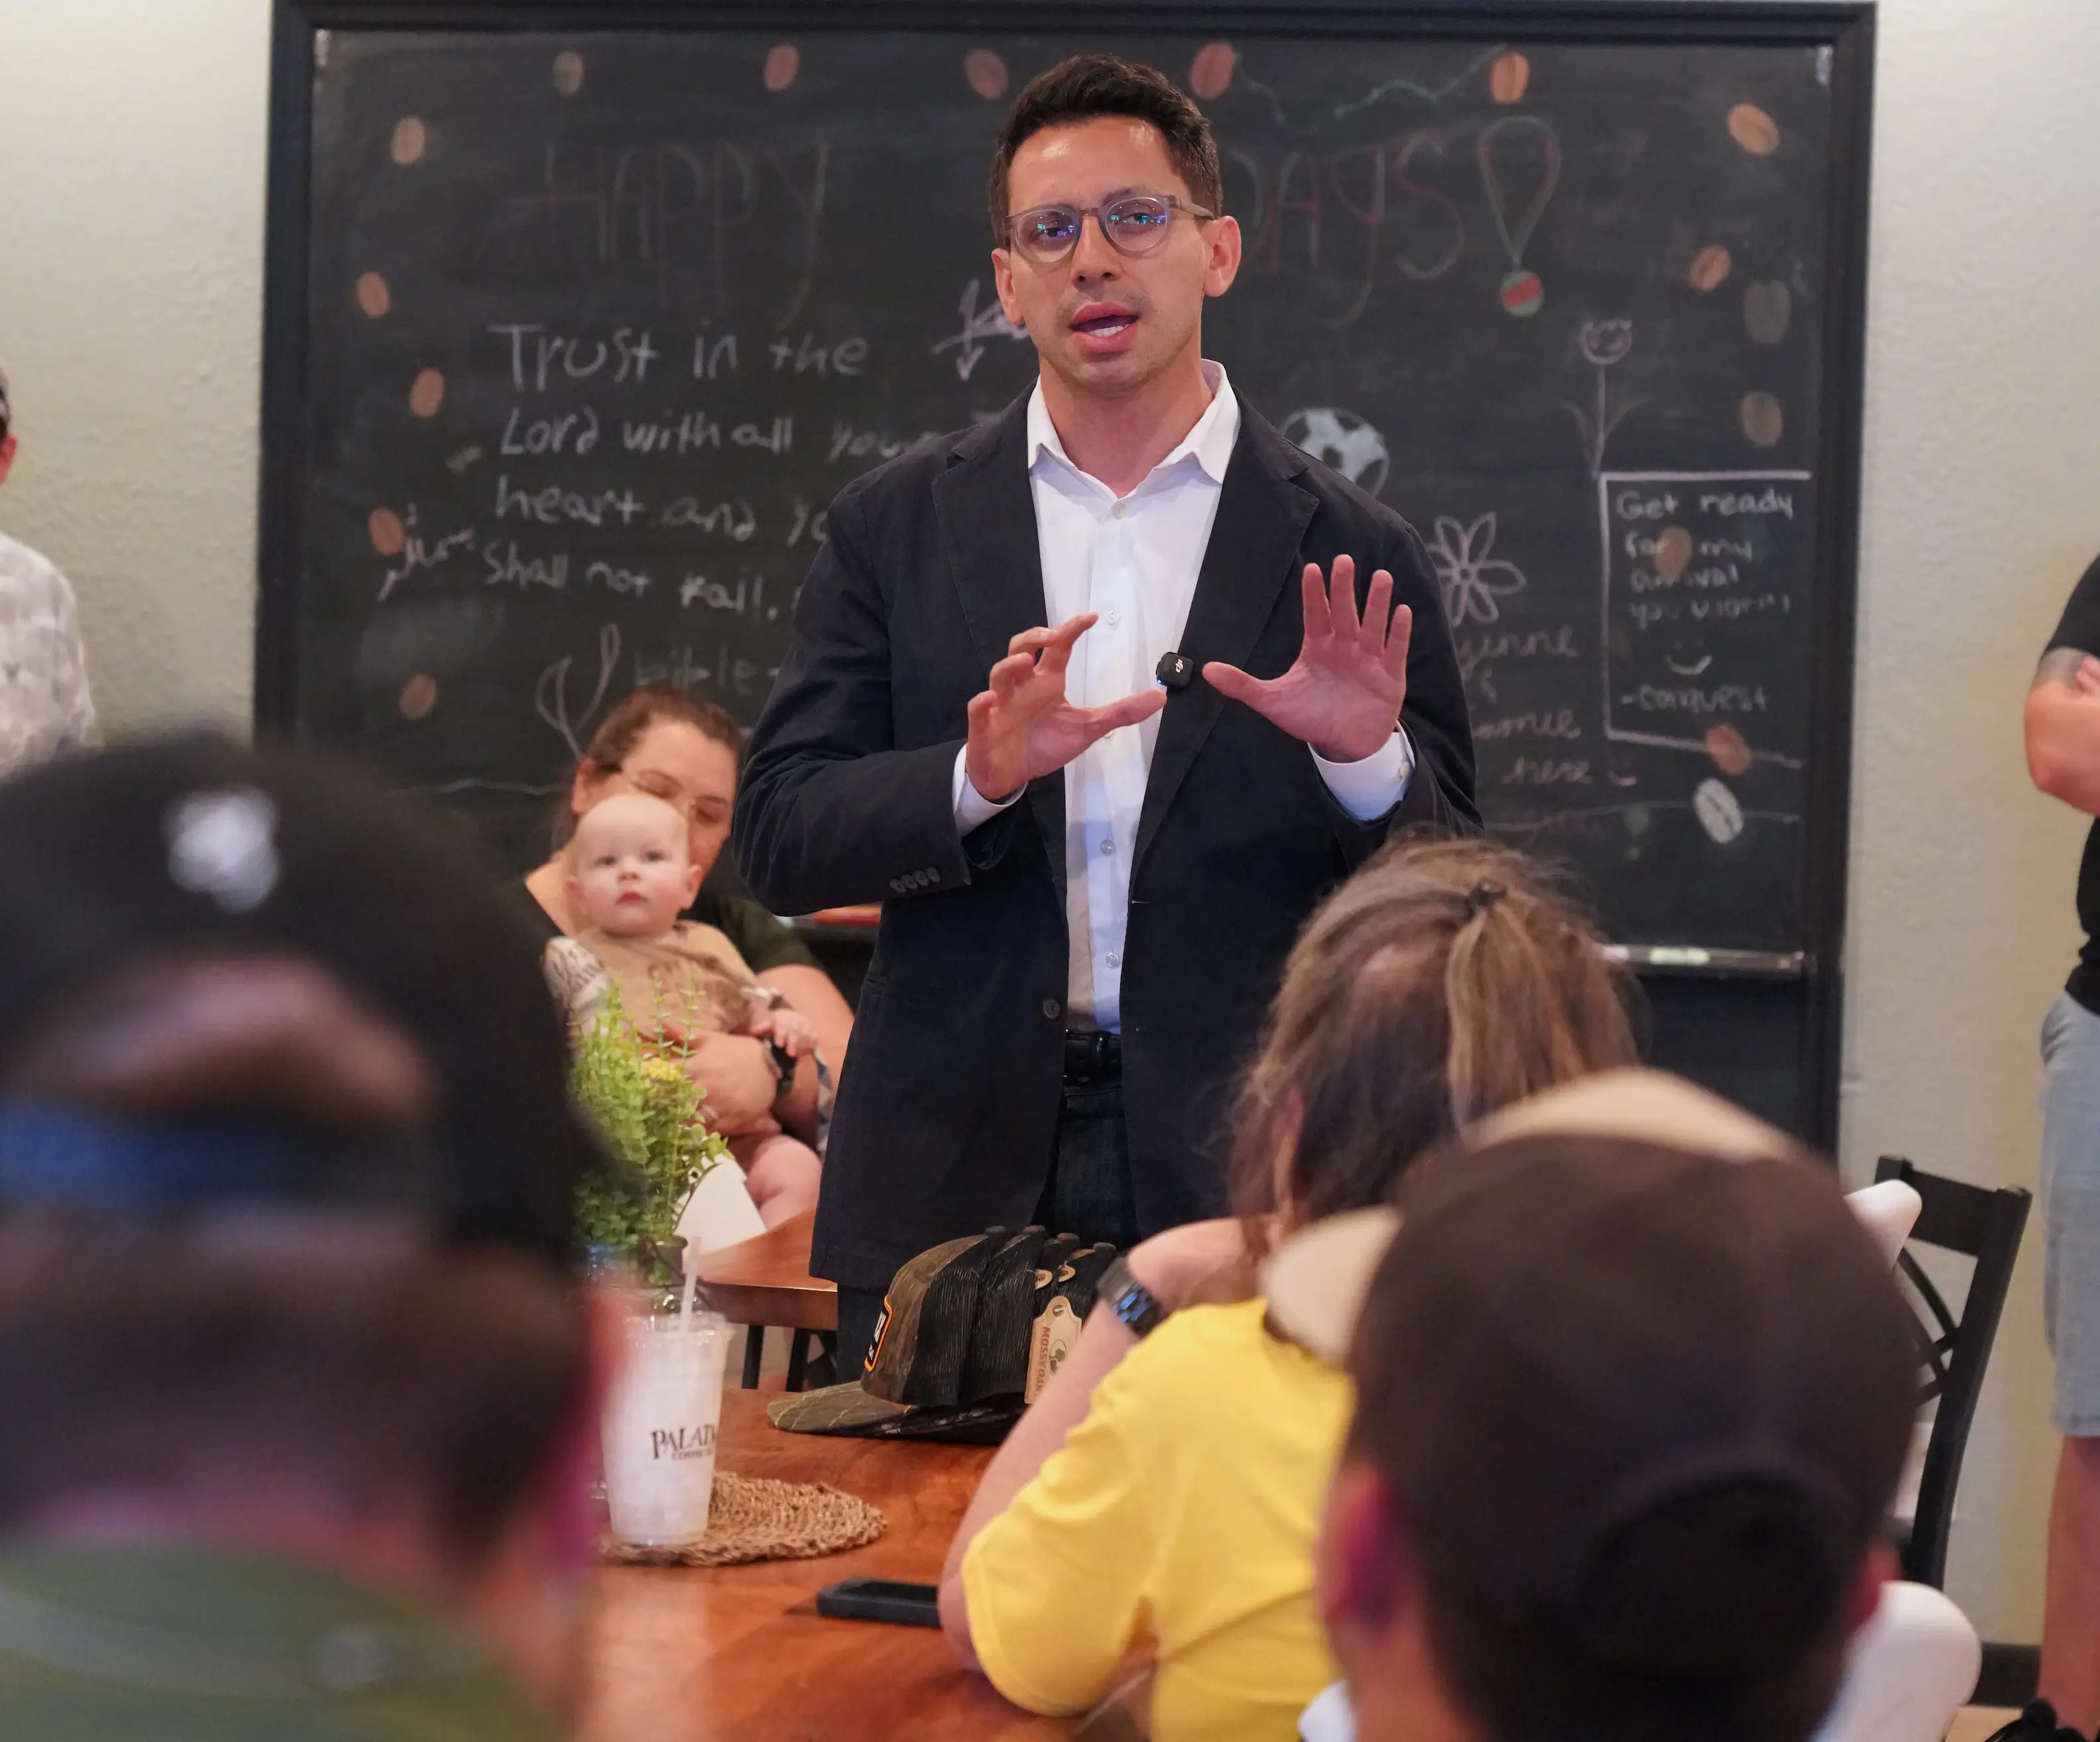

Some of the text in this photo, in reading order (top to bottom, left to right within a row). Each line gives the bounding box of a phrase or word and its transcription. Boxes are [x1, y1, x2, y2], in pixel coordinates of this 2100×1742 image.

[487, 318, 869, 392] Trust in the
[500, 404, 600, 455] Lord
[622, 408, 721, 455] with
[732, 416, 793, 454] all
[495, 473, 646, 526] heart
[661, 496, 757, 542] and
[1616, 484, 1794, 521] Get ready
[585, 561, 654, 599] not
[1038, 1326, 1051, 1367] MOSSY
